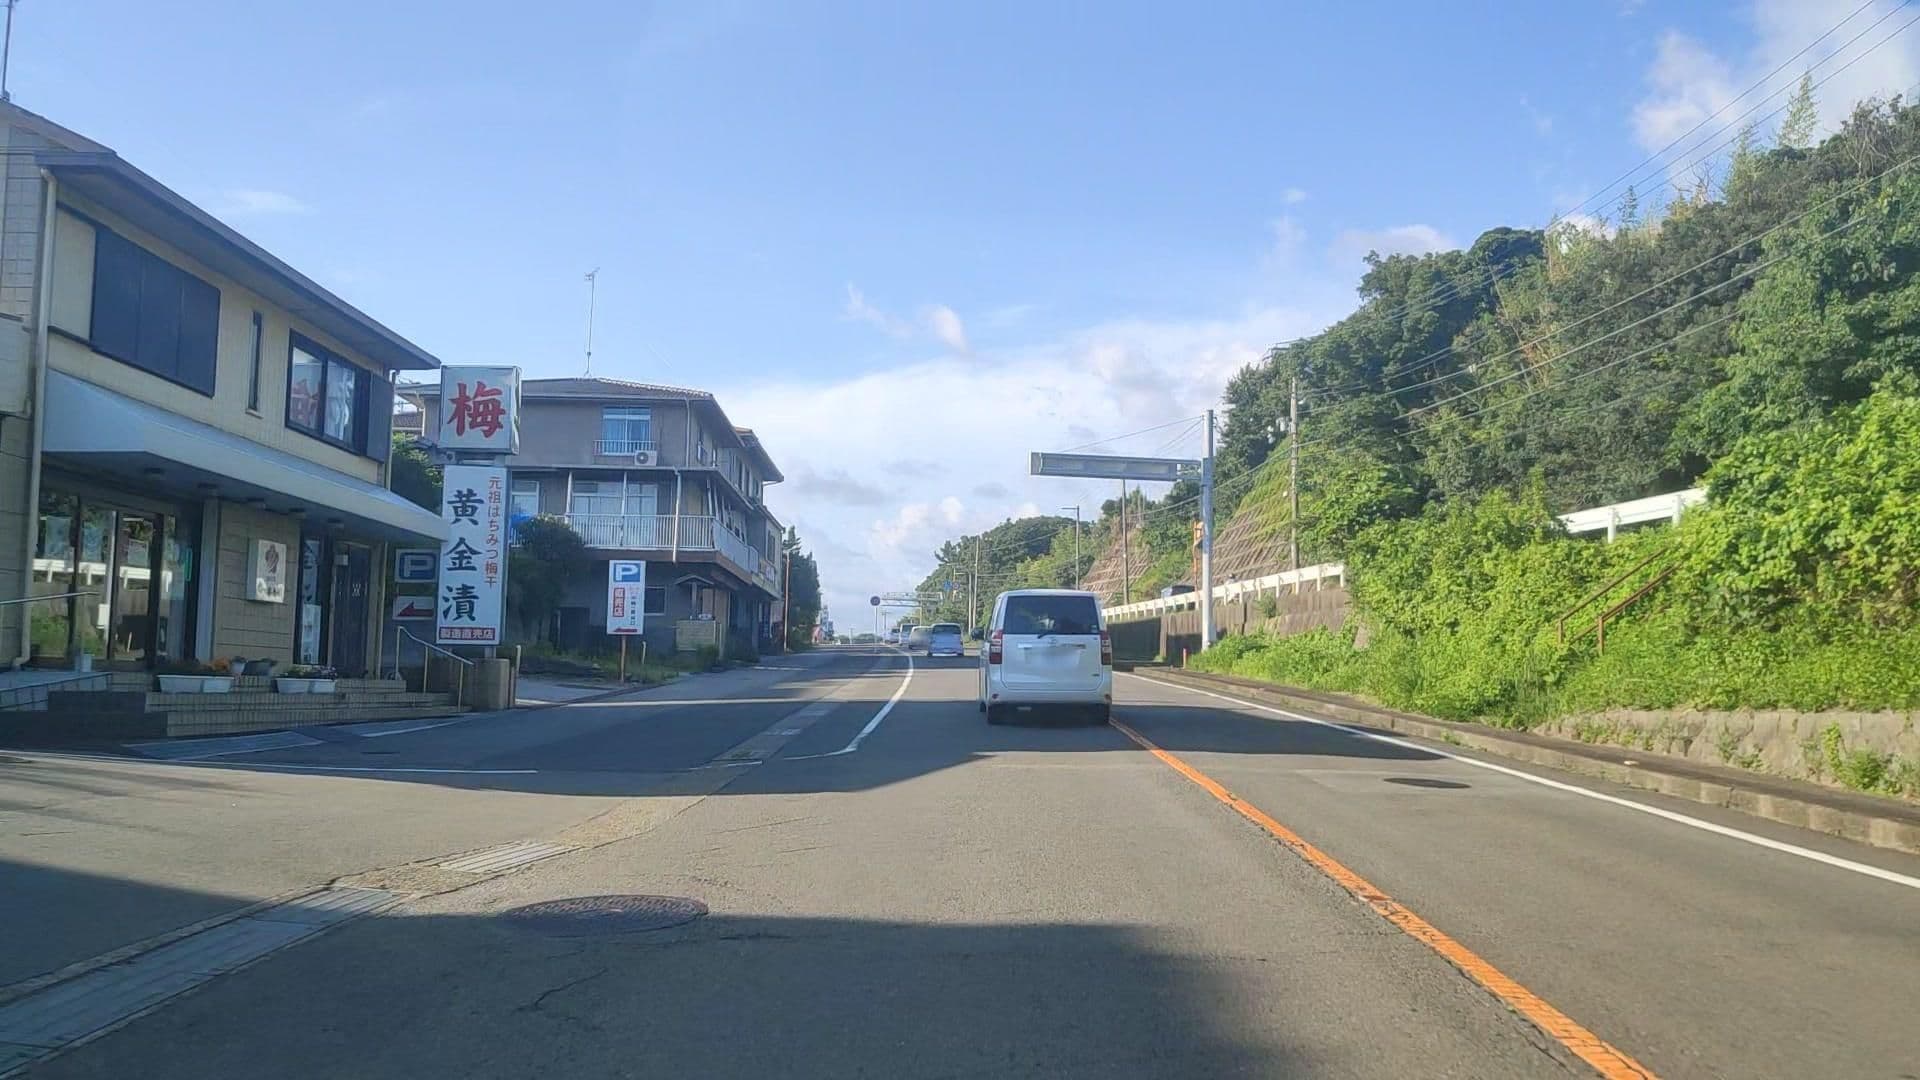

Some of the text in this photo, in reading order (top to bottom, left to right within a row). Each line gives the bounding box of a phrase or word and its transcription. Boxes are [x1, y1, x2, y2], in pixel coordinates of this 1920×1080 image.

[448, 381, 506, 438] 梅
[442, 488, 484, 622] 黄金漬
[484, 476, 502, 588] 元祖はちみつ梅干
[404, 555, 434, 577] P
[615, 564, 639, 581] P
